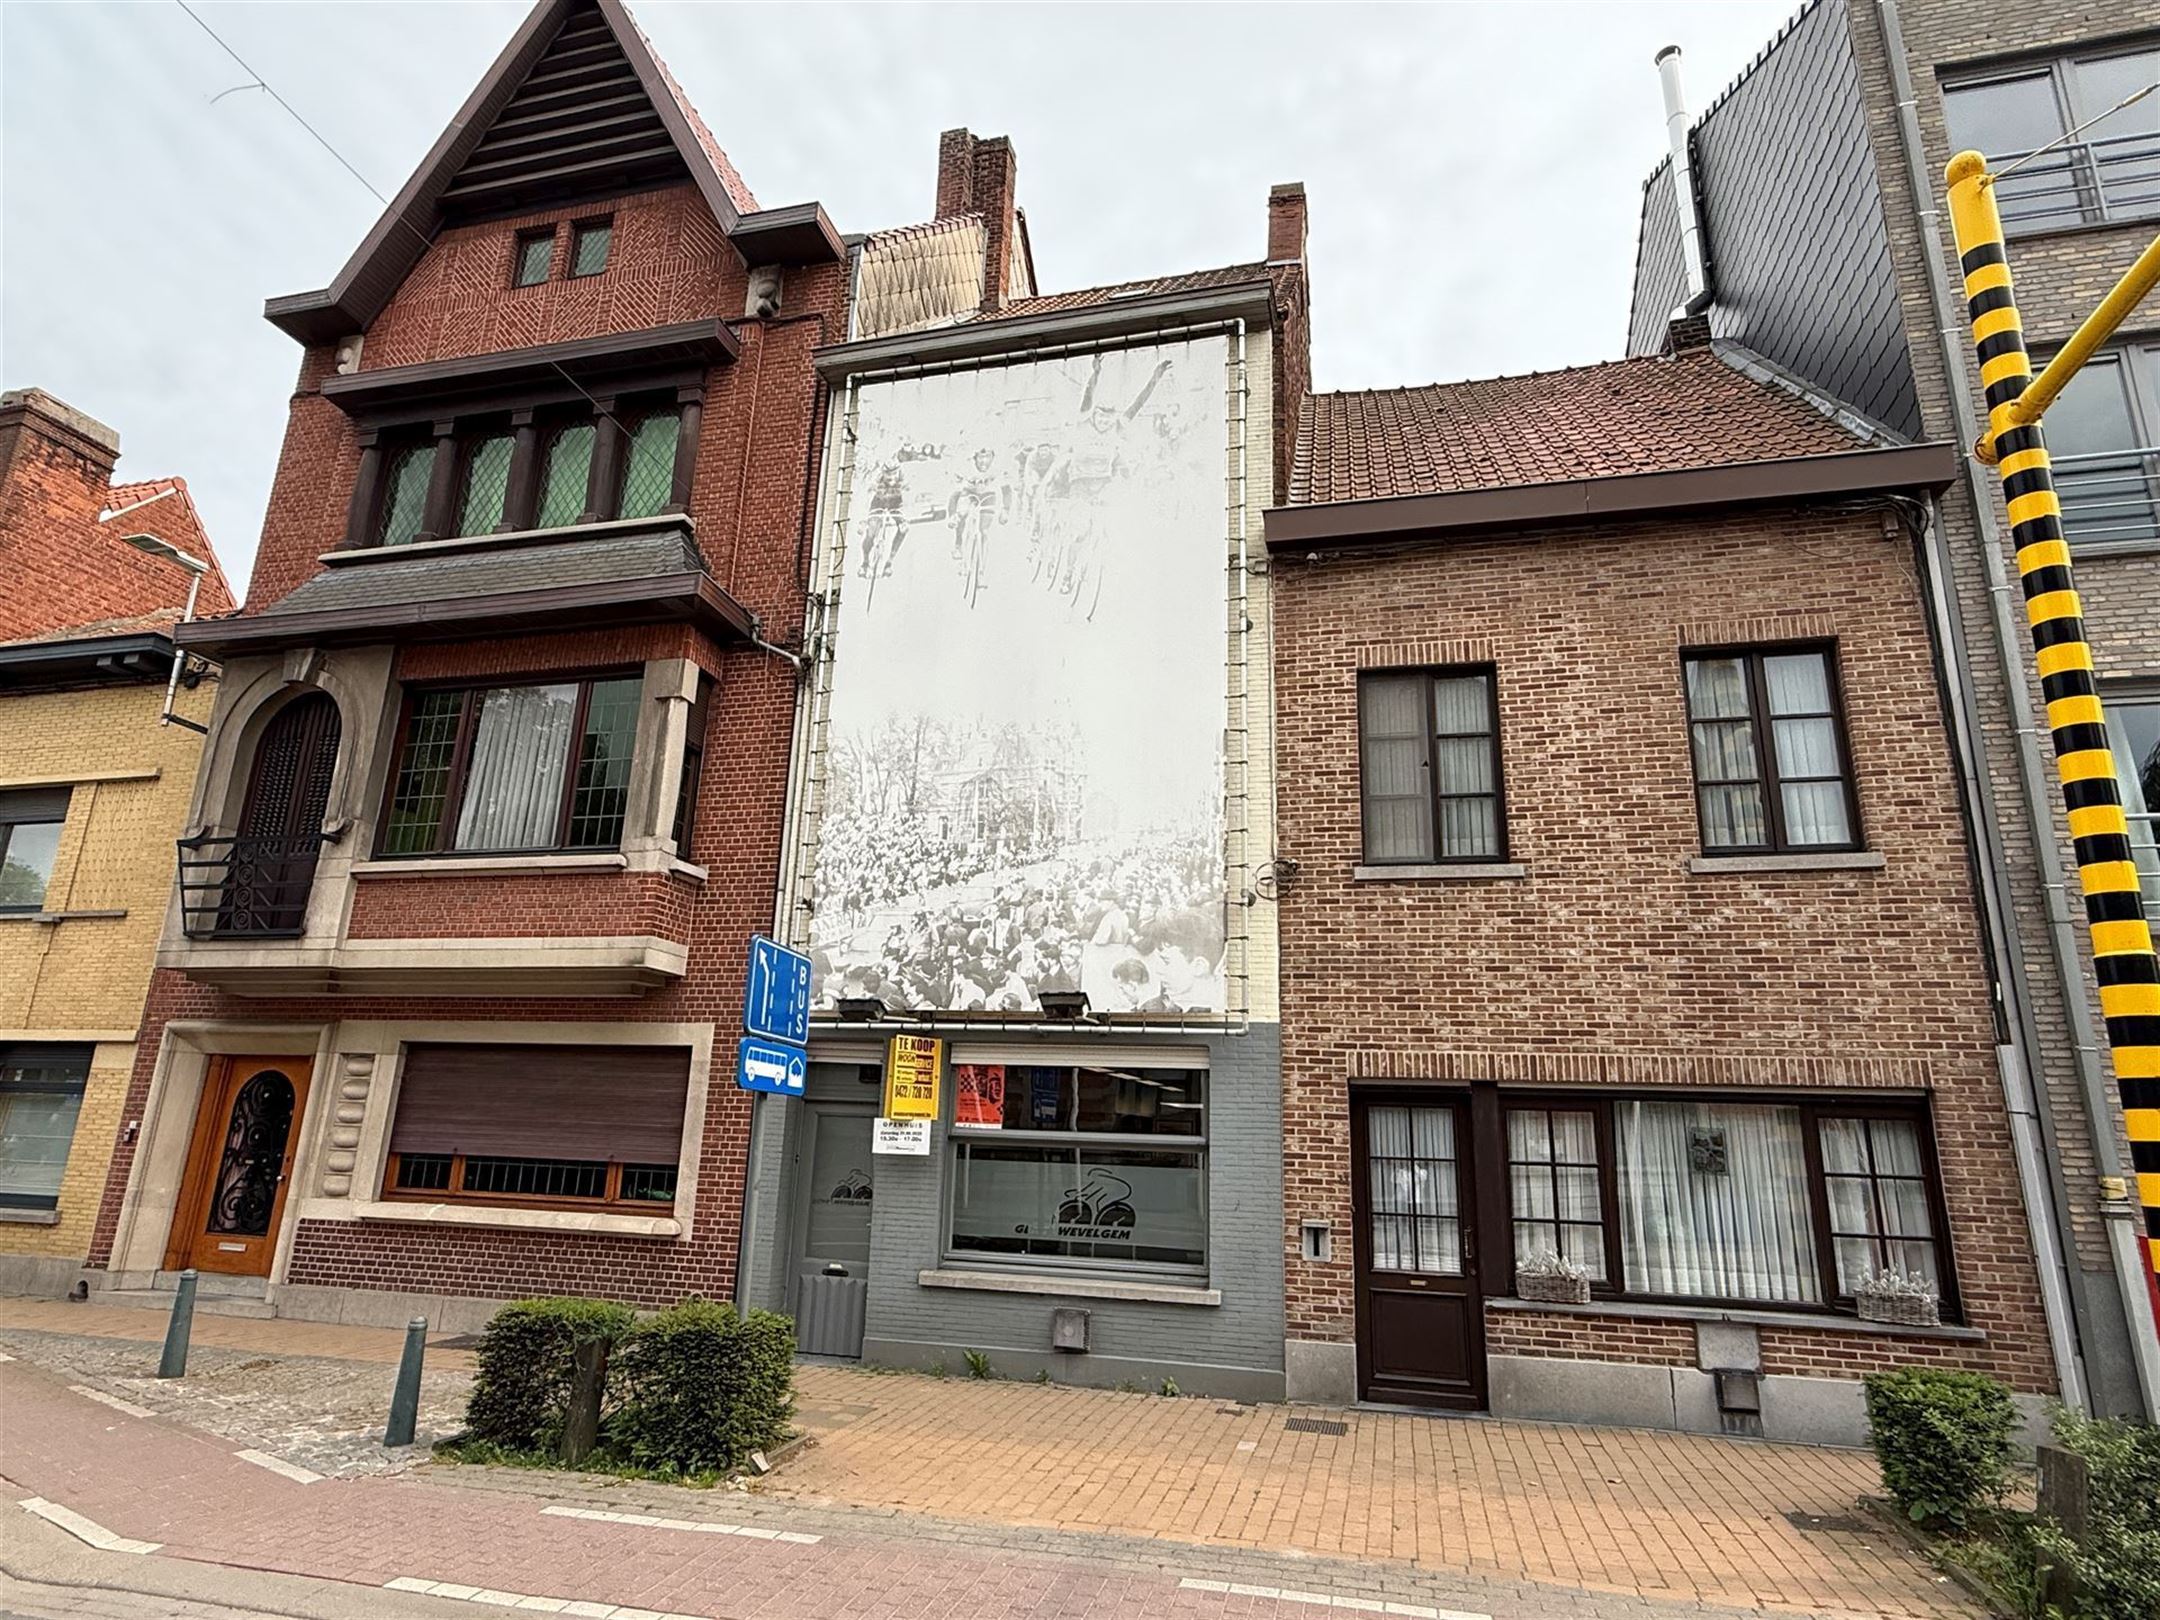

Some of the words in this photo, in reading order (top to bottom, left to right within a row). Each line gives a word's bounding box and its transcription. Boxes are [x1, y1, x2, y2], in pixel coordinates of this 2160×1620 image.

[796, 965, 807, 1034] BUS
[898, 1036, 909, 1051] TE
[911, 1038, 935, 1053] KOOP
[882, 1121, 923, 1129] OPENHUIS
[1058, 1226, 1131, 1240] WEVELGEM
